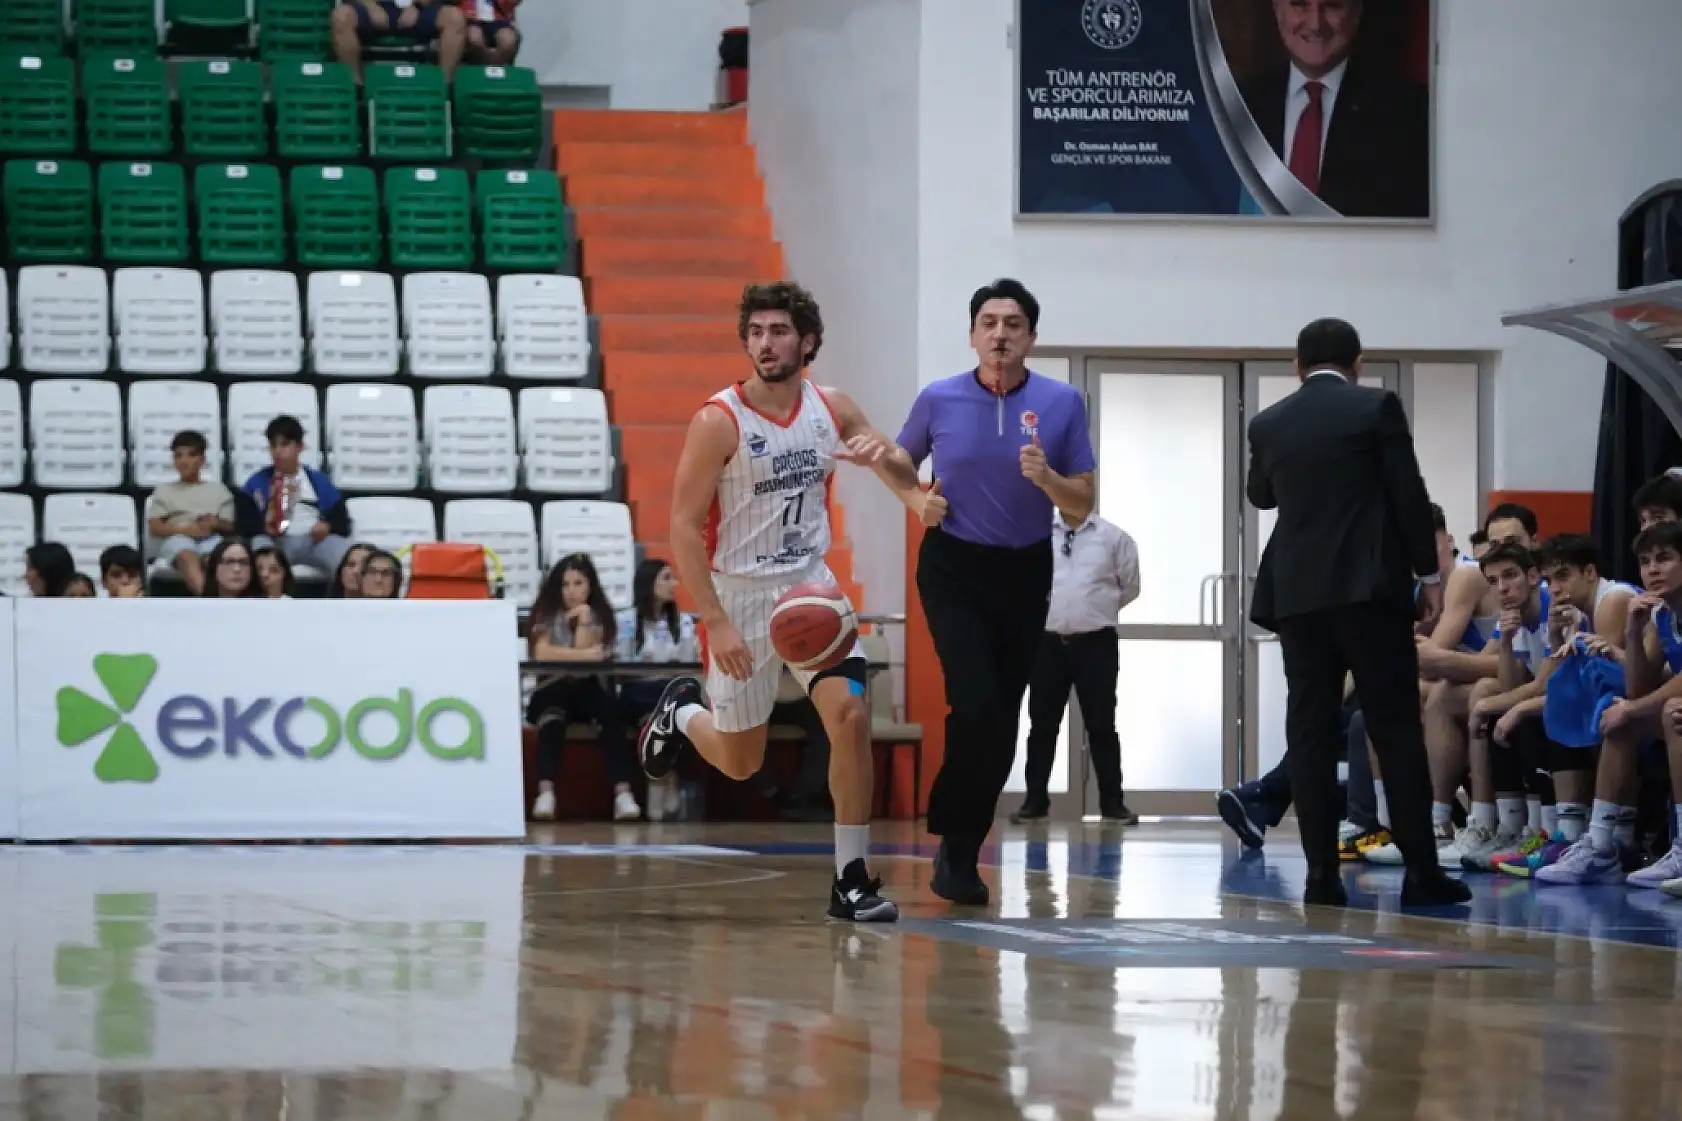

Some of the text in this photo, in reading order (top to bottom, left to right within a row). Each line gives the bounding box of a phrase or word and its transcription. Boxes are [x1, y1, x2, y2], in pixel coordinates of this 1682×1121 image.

[1046, 68, 1177, 88] TÜM ANTRENÖR
[1028, 87, 1195, 105] VE SPORCULARIMIZA
[1032, 105, 1190, 122] BAŞARILAR DİLİYORUM
[1109, 154, 1133, 165] SPOR
[782, 491, 804, 527] 77
